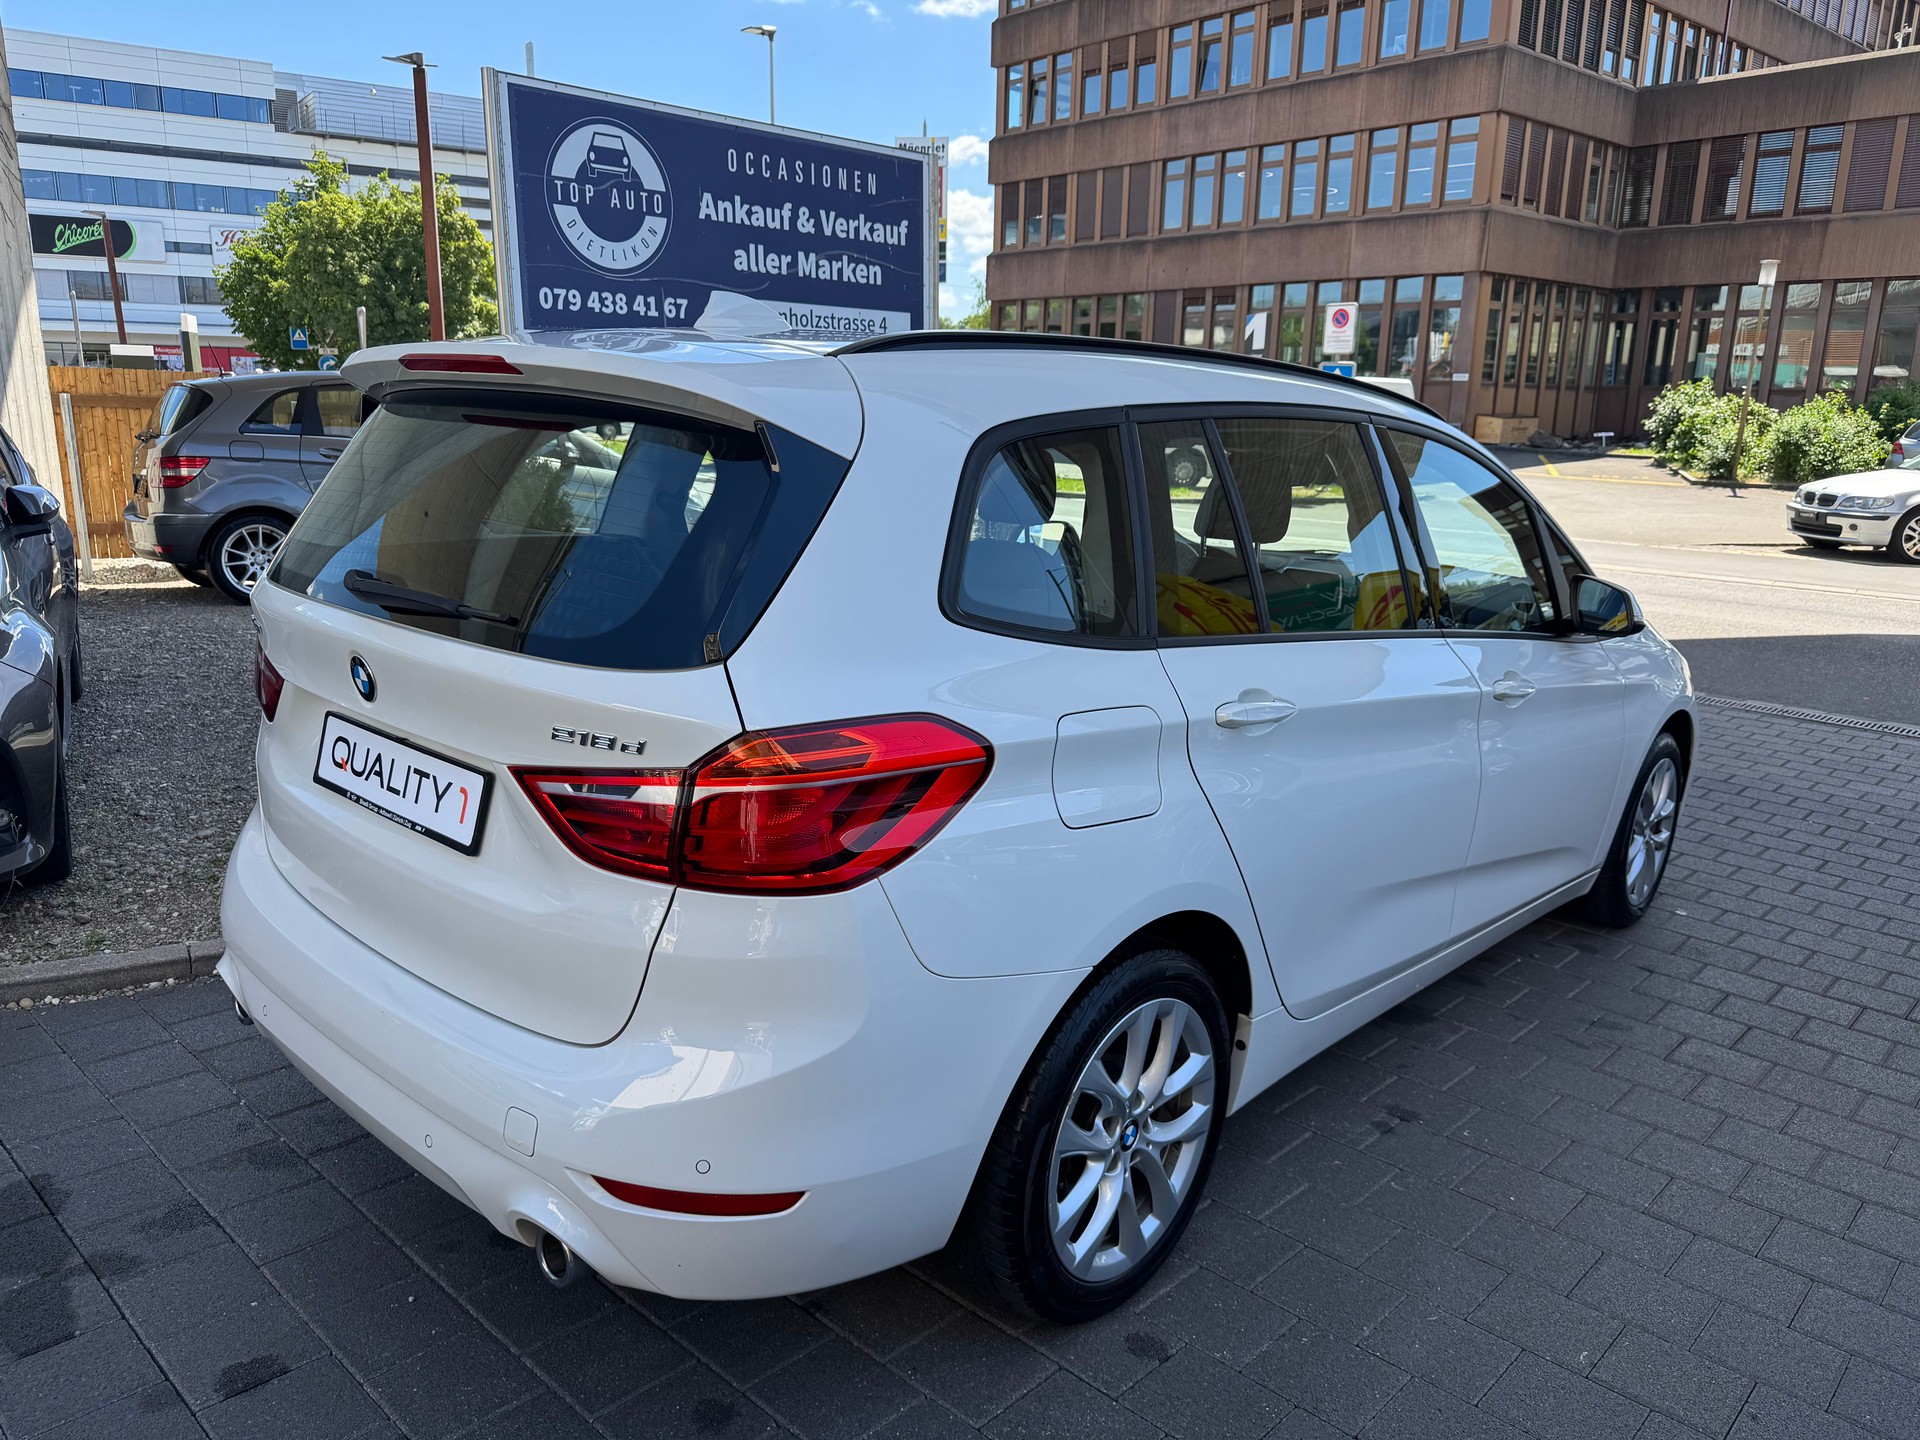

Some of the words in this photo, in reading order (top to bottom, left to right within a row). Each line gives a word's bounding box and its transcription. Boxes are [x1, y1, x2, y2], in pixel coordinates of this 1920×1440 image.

[727, 148, 877, 195] OCCASIONEN
[554, 180, 594, 205] TOP
[610, 187, 663, 214] AUTO
[566, 219, 659, 262] DIETLIKON
[698, 192, 792, 231] Ankauf
[796, 206, 816, 234] &
[819, 209, 909, 246] Verkauf
[733, 243, 792, 275] aller
[797, 250, 883, 286] Marken
[539, 286, 582, 312] 079
[587, 290, 628, 315] 438
[632, 294, 659, 317] 41
[663, 297, 688, 319] 67
[879, 316, 888, 333] 4
[331, 735, 454, 814] QUALITY
